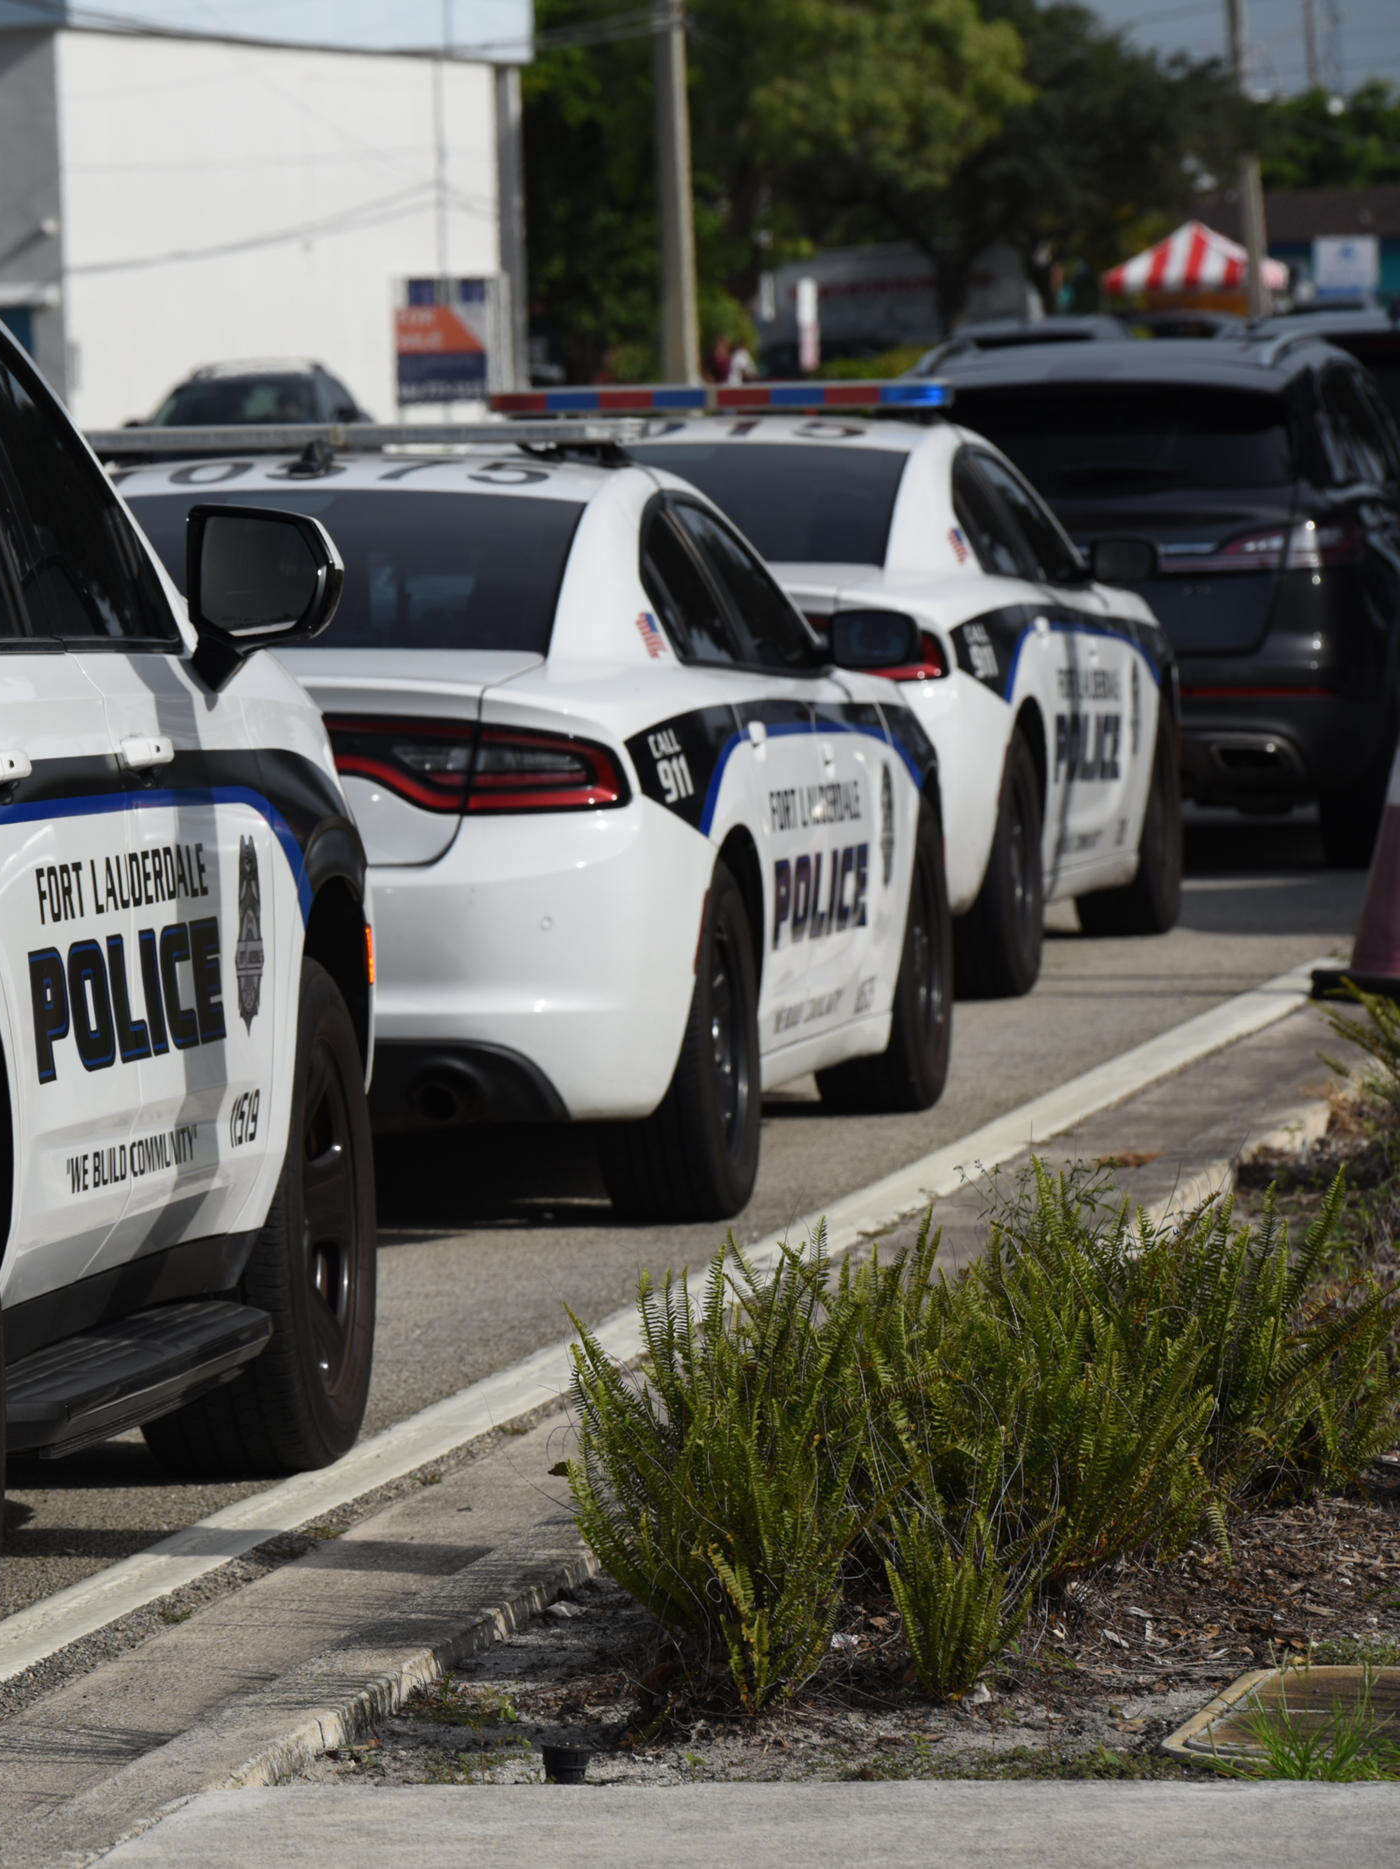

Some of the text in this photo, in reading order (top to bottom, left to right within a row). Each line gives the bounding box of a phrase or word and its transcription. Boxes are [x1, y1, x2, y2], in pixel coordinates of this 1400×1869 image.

[647, 728, 681, 760] CALL
[656, 753, 695, 804] 911
[768, 788, 798, 833] FORT
[35, 843, 209, 925] FORT LAUDERDALE
[772, 842, 869, 951] POLICE
[27, 916, 227, 1085] POLICE
[93, 1144, 127, 1189] BUILD
